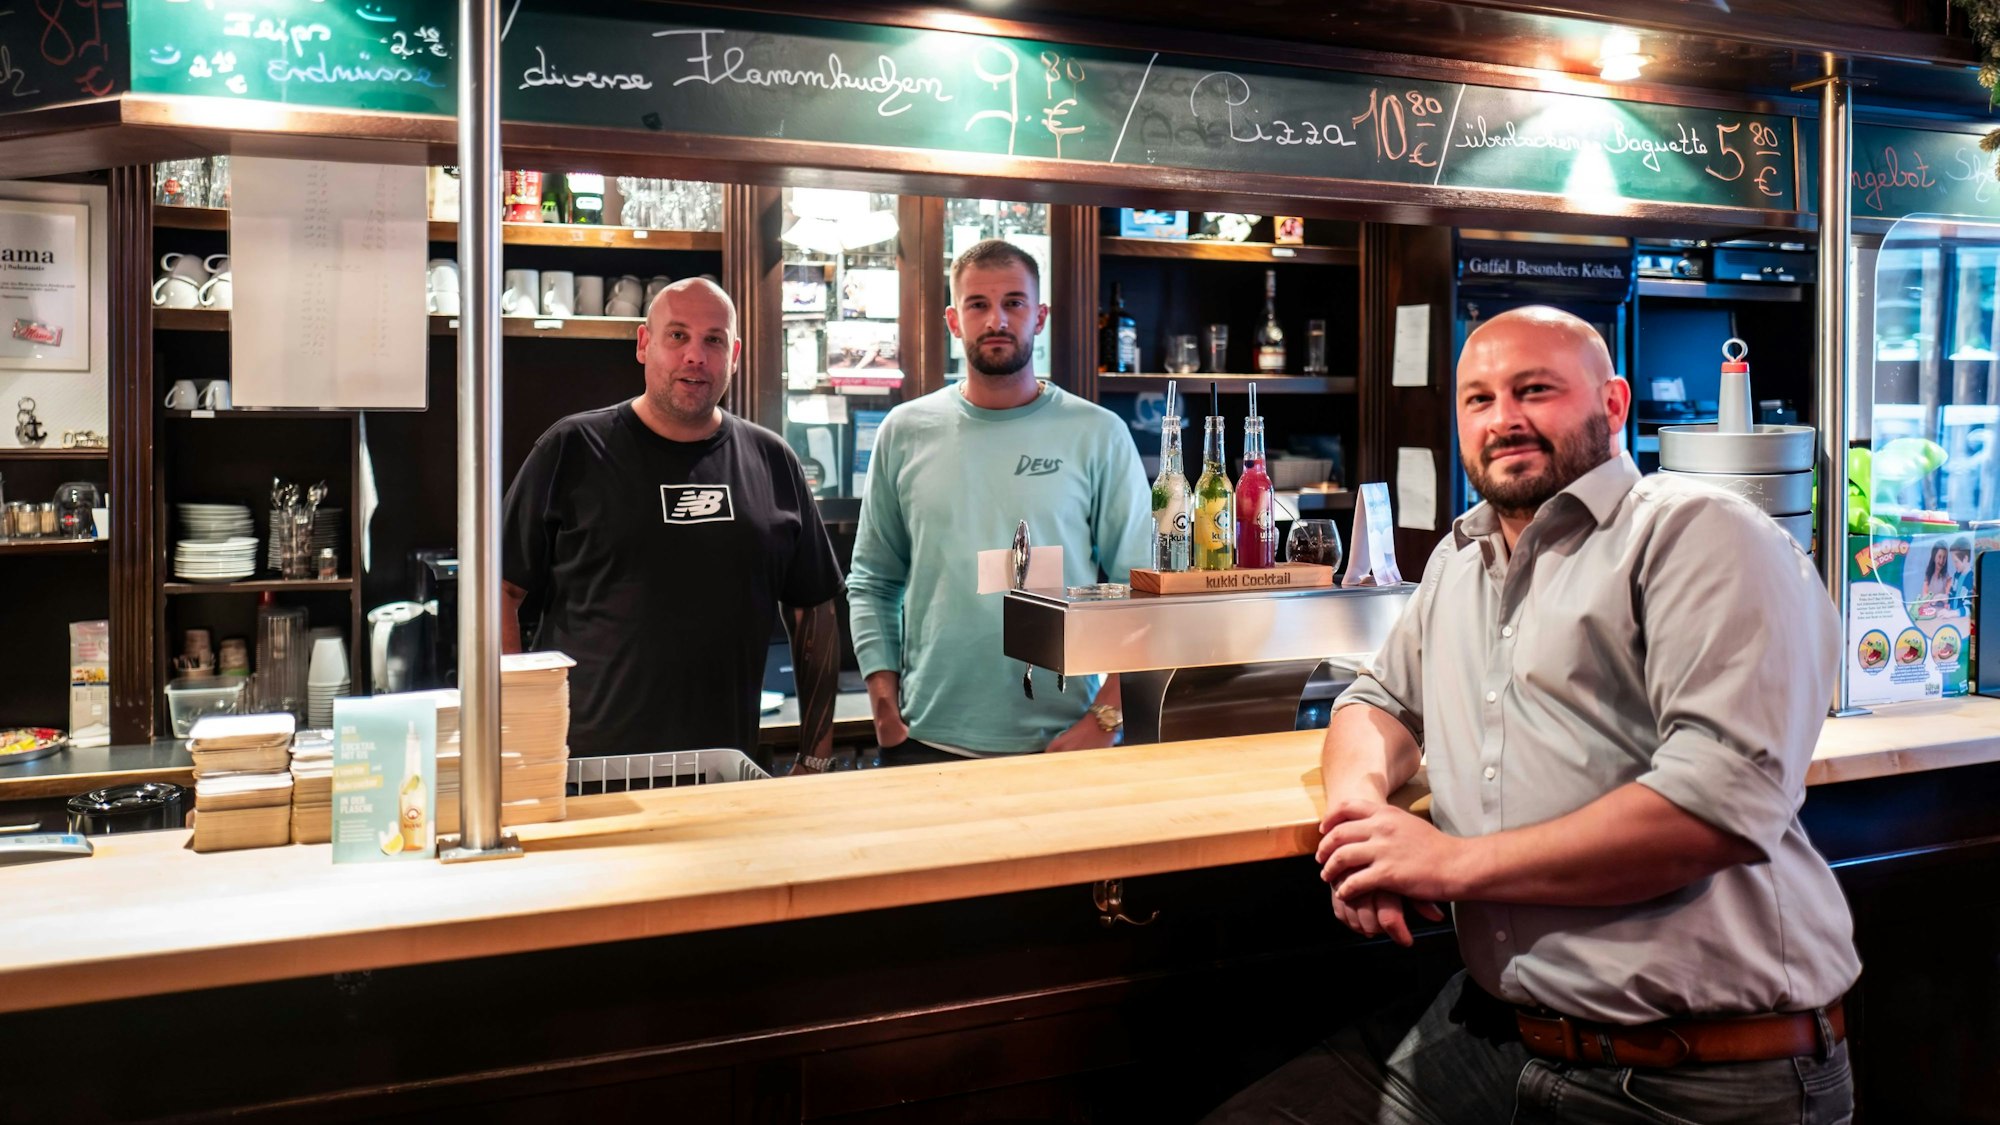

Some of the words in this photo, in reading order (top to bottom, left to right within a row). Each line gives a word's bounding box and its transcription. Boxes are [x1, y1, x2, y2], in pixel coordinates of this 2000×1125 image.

[266, 52, 447, 88] Erdnüsse
[518, 46, 653, 90] diverse
[652, 29, 954, 117] Flammkuchen
[1190, 71, 1357, 147] Pizza
[1603, 118, 1709, 173] Baguette
[1851, 146, 1936, 211] ngebot
[1469, 257, 1512, 275] Gaffel.
[1516, 259, 1579, 278] Besonders
[1581, 262, 1625, 280] Kölsch.
[1206, 574, 1238, 589] kukki
[1242, 572, 1291, 587] Cocktail
